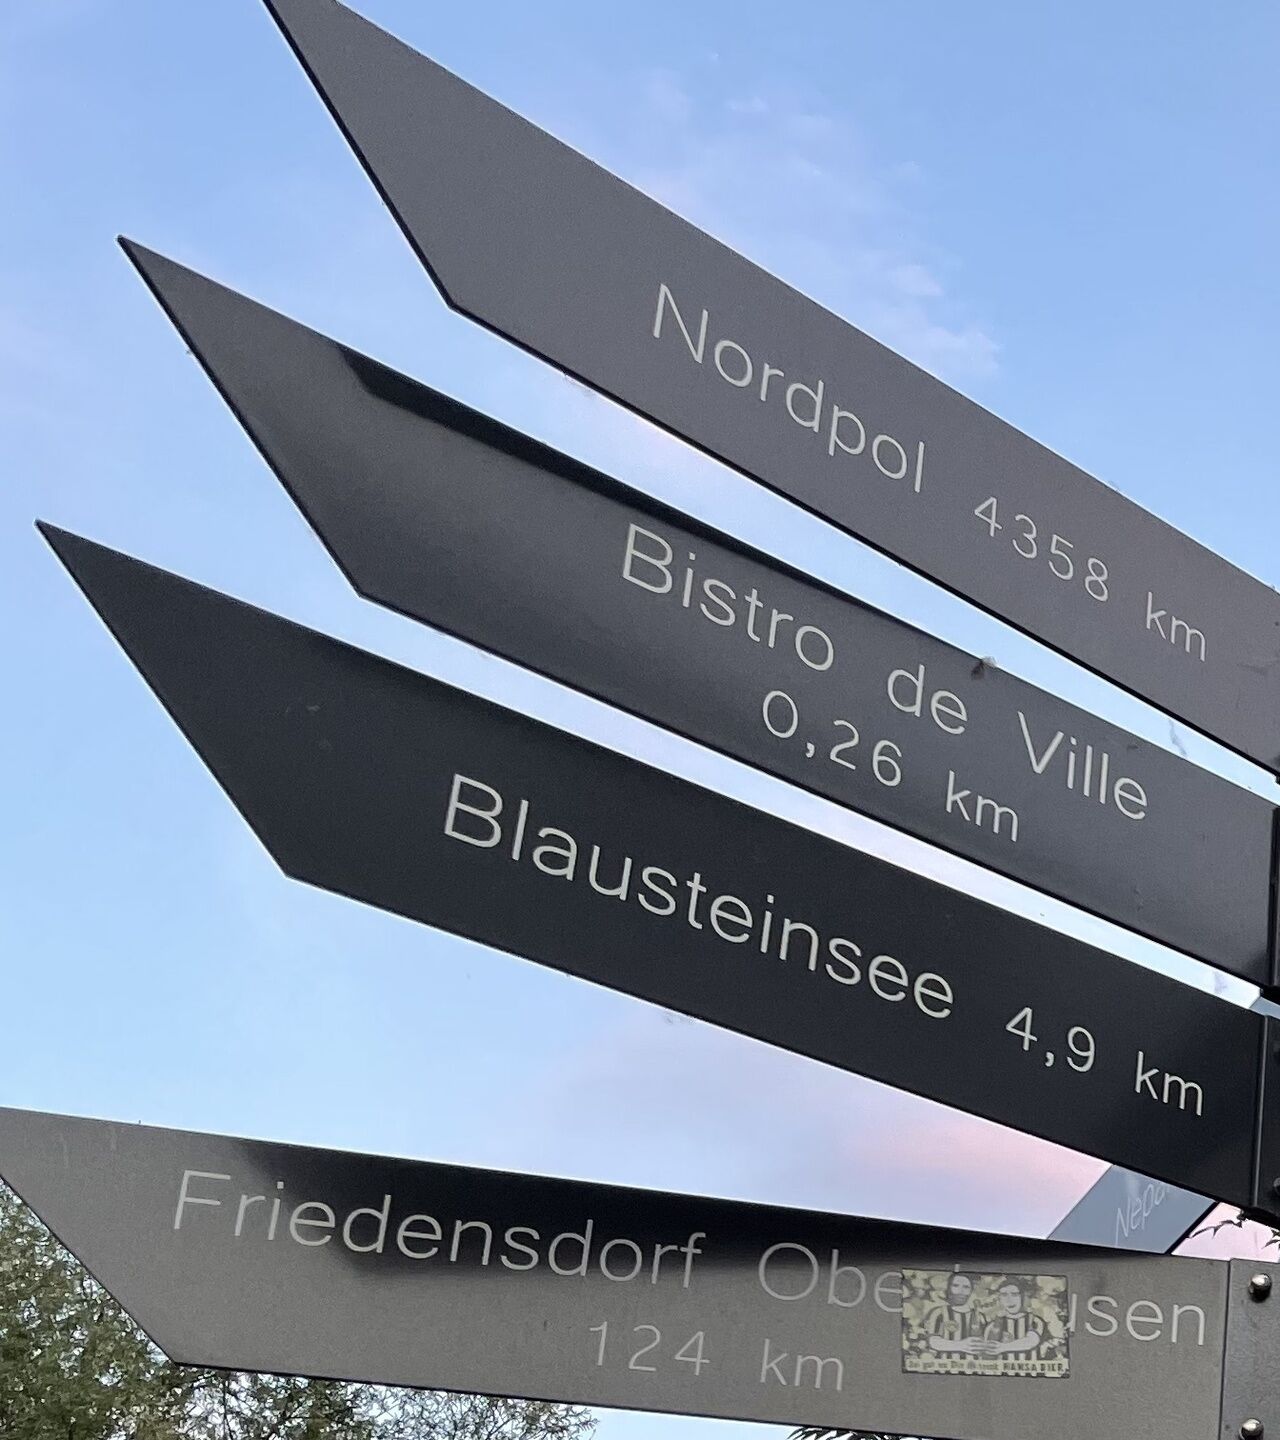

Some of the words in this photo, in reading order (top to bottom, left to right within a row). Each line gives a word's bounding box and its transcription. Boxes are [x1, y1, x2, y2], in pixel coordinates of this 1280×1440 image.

[652, 283, 926, 493] Nordpol
[973, 496, 1110, 602] 4358
[1145, 592, 1206, 662] km
[622, 523, 834, 672] Bistro
[887, 664, 967, 735] de
[1018, 711, 1148, 821] Ville
[762, 690, 903, 787] 0,26
[946, 771, 1019, 843] km
[442, 773, 955, 1020] Blausteinsee
[1005, 1006, 1097, 1074] 4,9
[1135, 1050, 1205, 1117] km
[173, 1169, 703, 1288] Friedensdorf
[759, 1242, 1206, 1346] Obesen
[590, 1320, 710, 1375] 124
[760, 1339, 844, 1391] km
